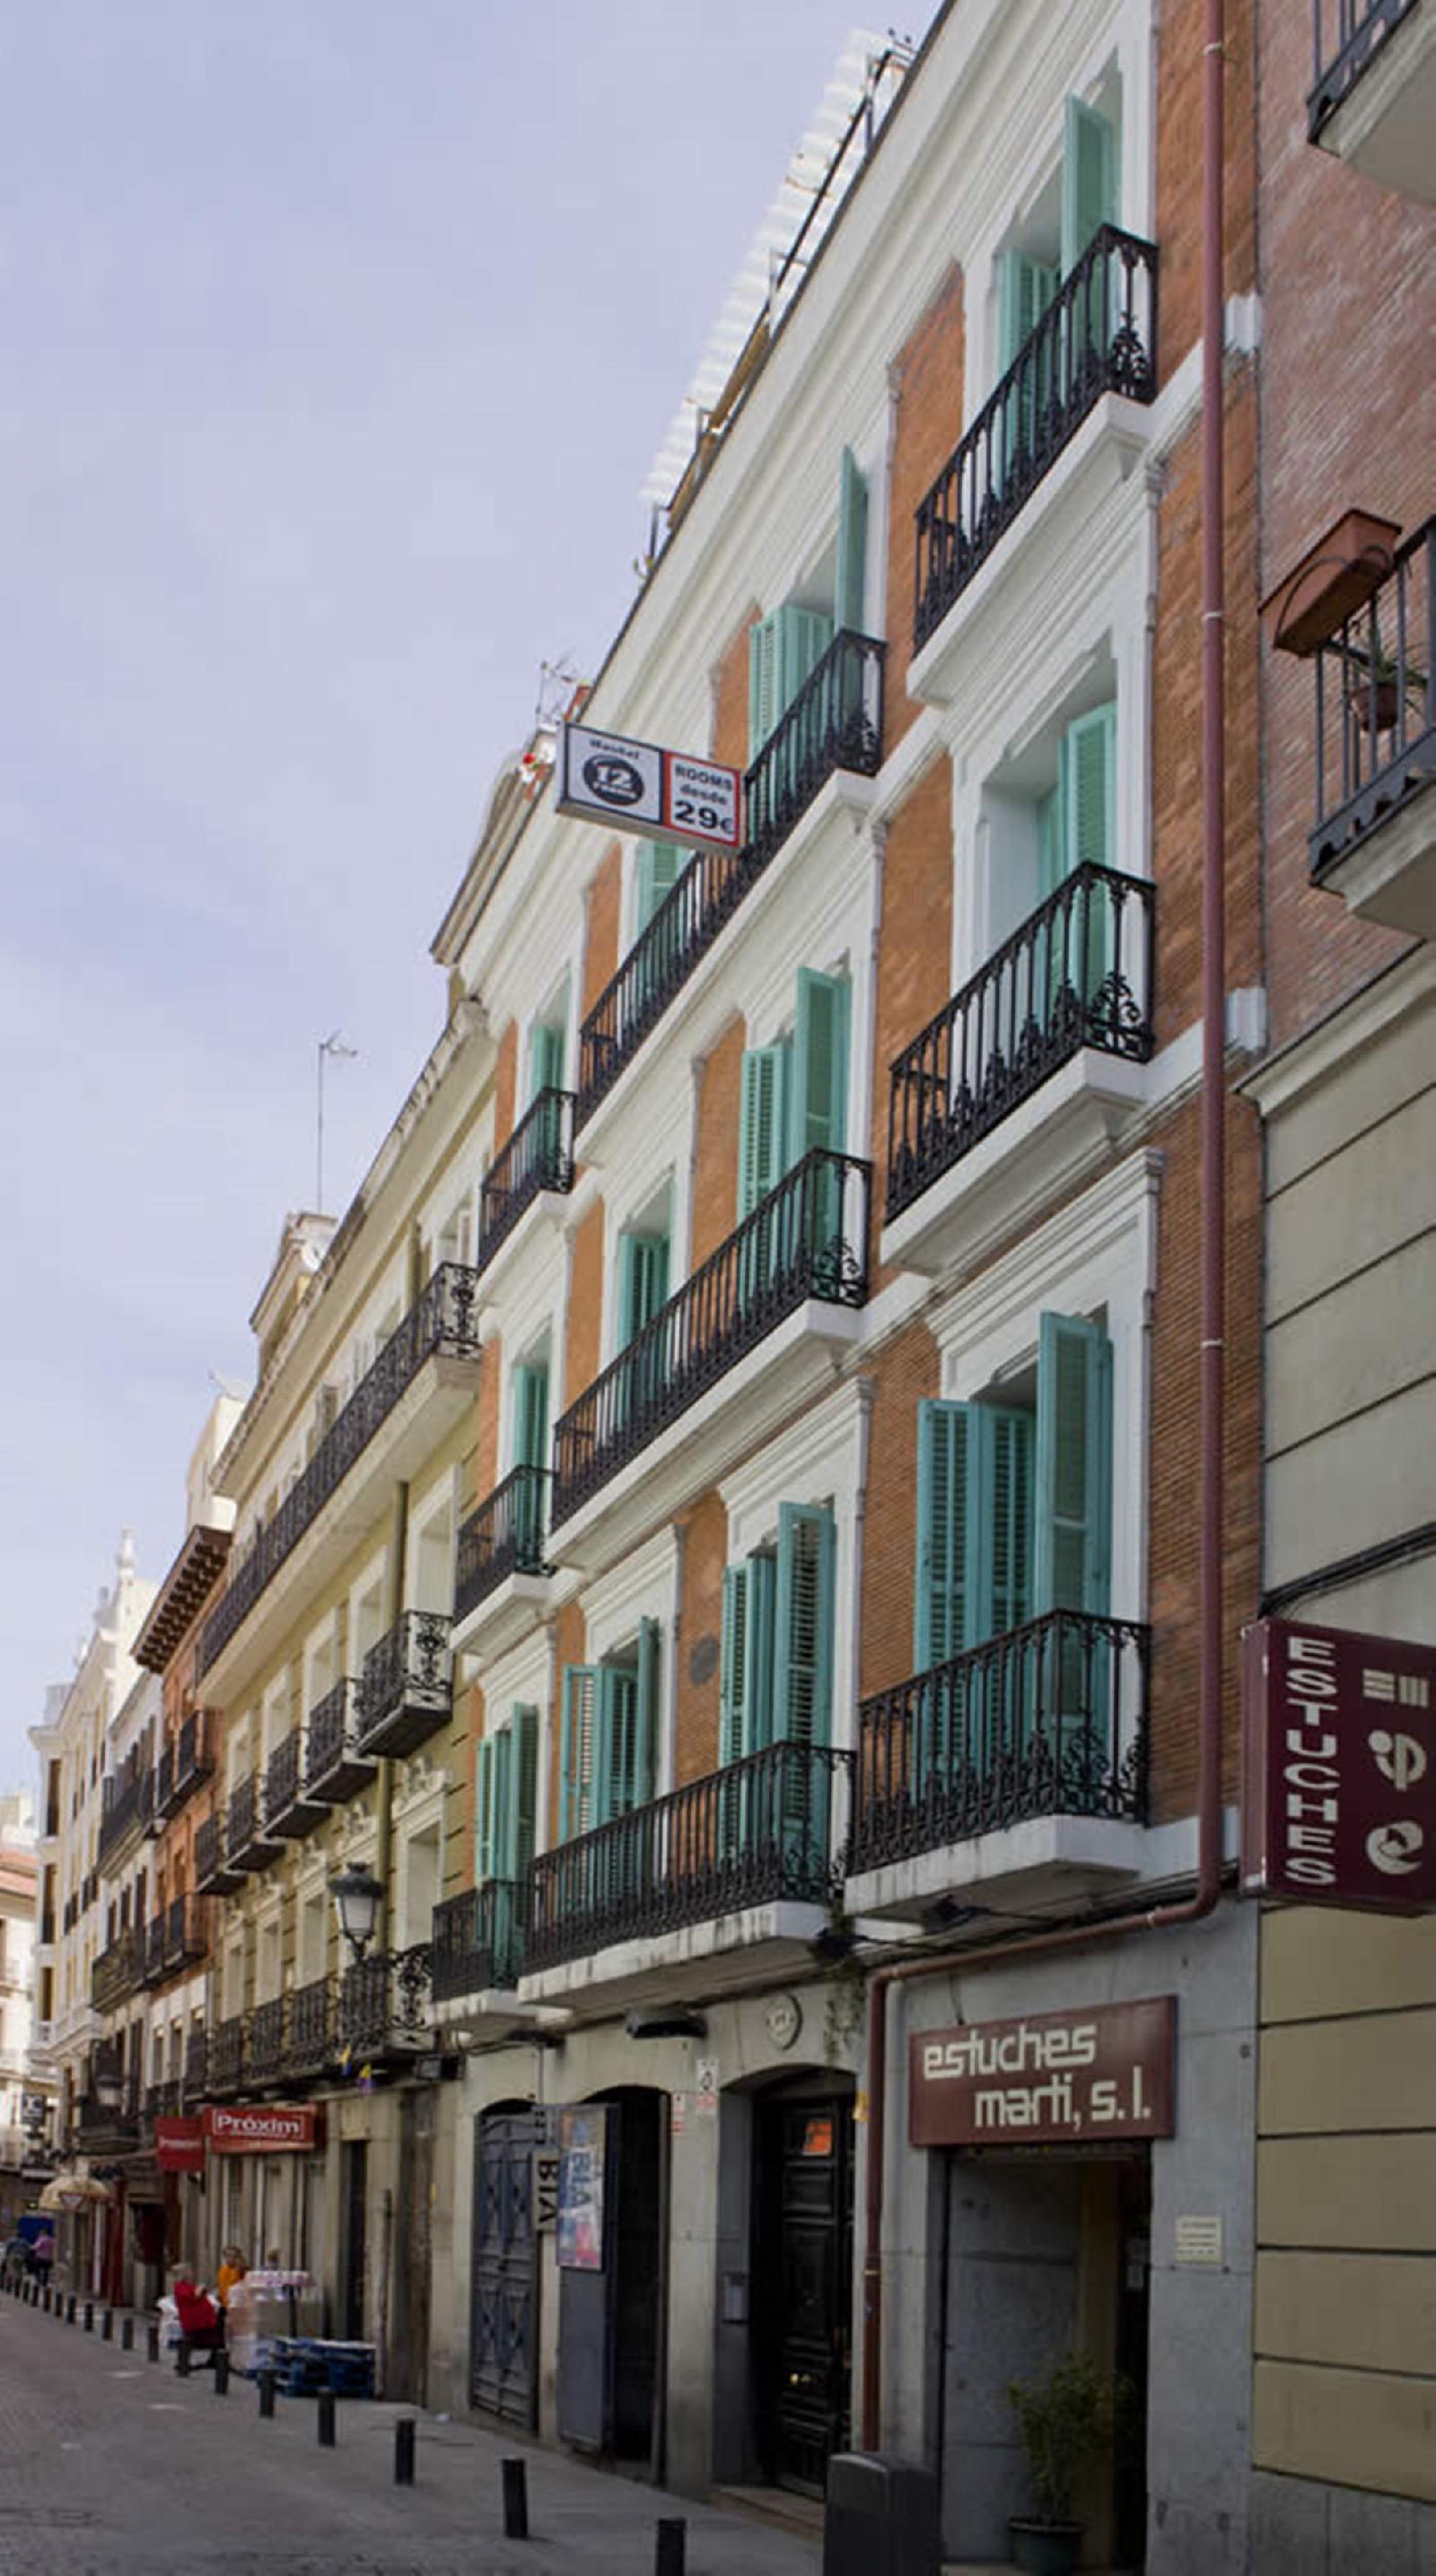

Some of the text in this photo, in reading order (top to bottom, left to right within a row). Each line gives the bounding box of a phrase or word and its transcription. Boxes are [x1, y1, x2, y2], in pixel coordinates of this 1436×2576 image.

[675, 764, 732, 790] ROOMS
[679, 783, 728, 805] desde
[1283, 1636, 1340, 1885] ESTUCHES
[924, 2024, 1098, 2081] estuches
